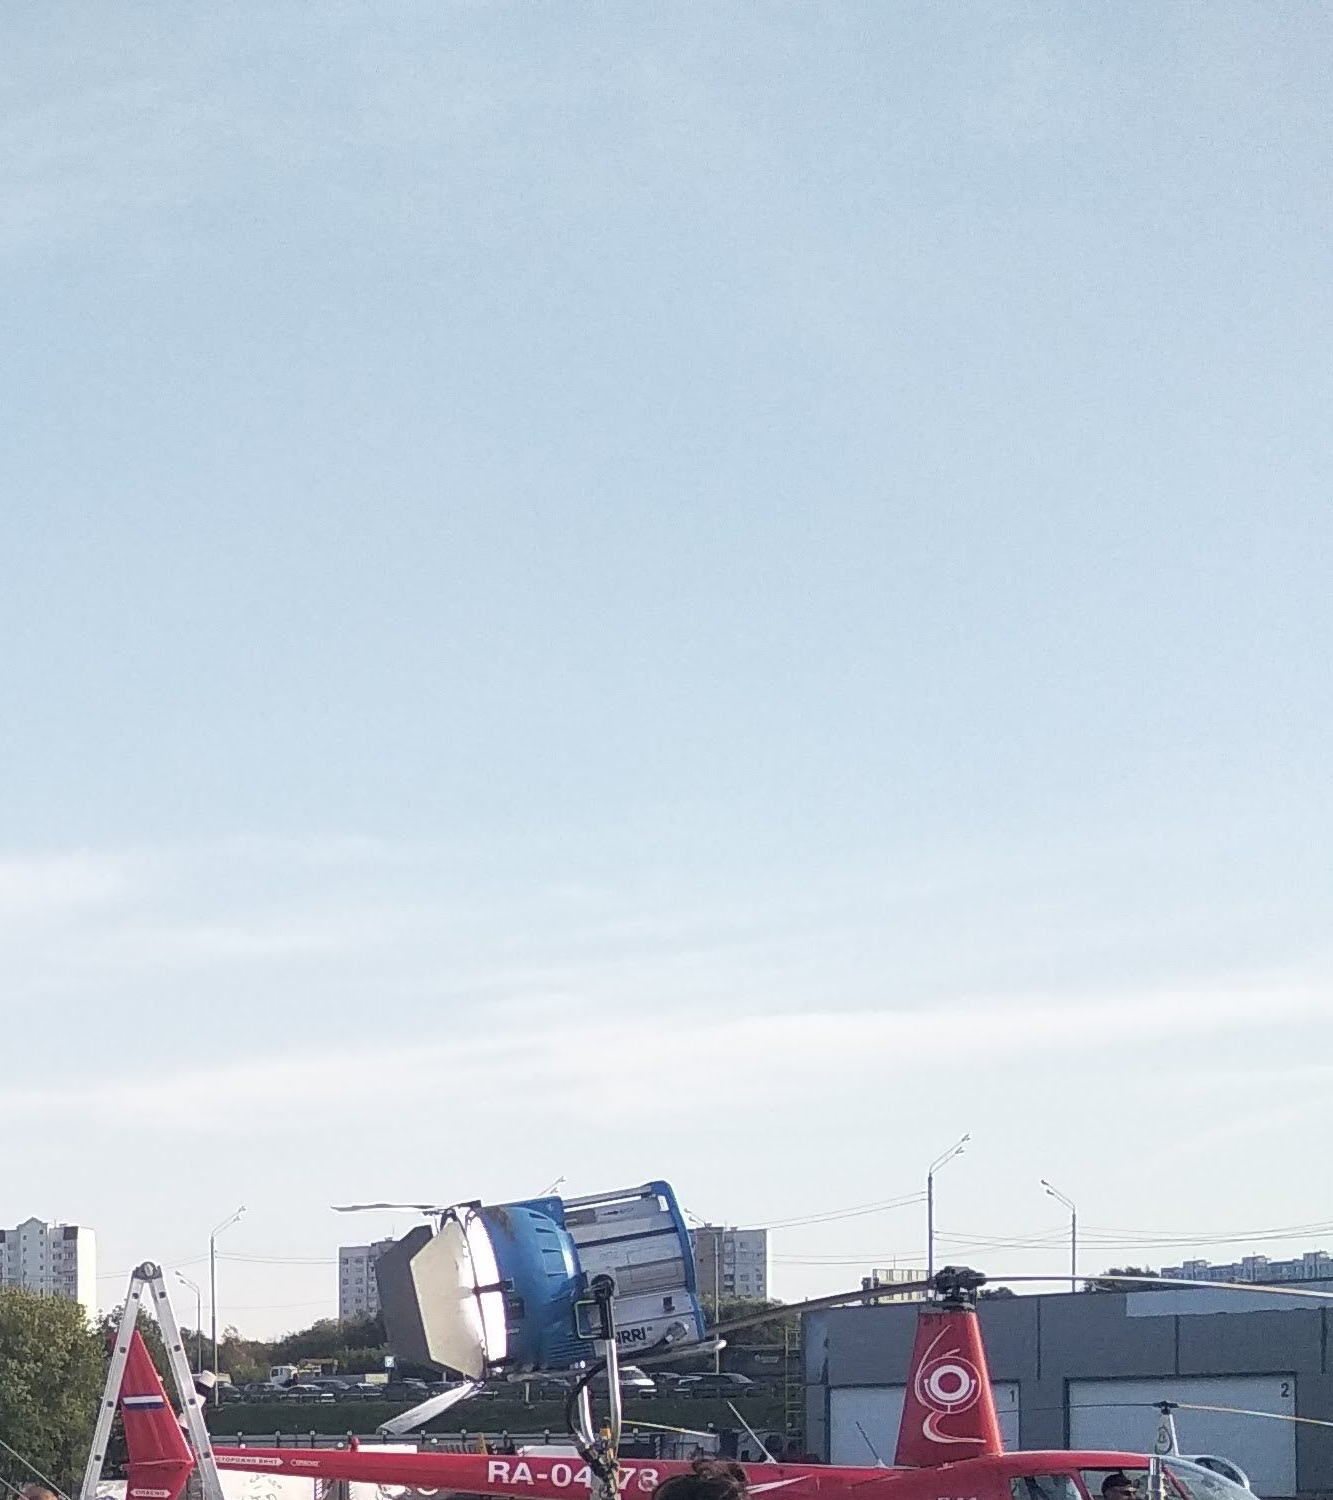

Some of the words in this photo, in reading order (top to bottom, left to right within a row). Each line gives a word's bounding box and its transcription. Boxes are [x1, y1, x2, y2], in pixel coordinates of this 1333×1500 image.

[1009, 1389, 1015, 1403] 1
[1280, 1382, 1290, 1398] 2
[487, 1460, 660, 1492] RA-0478
